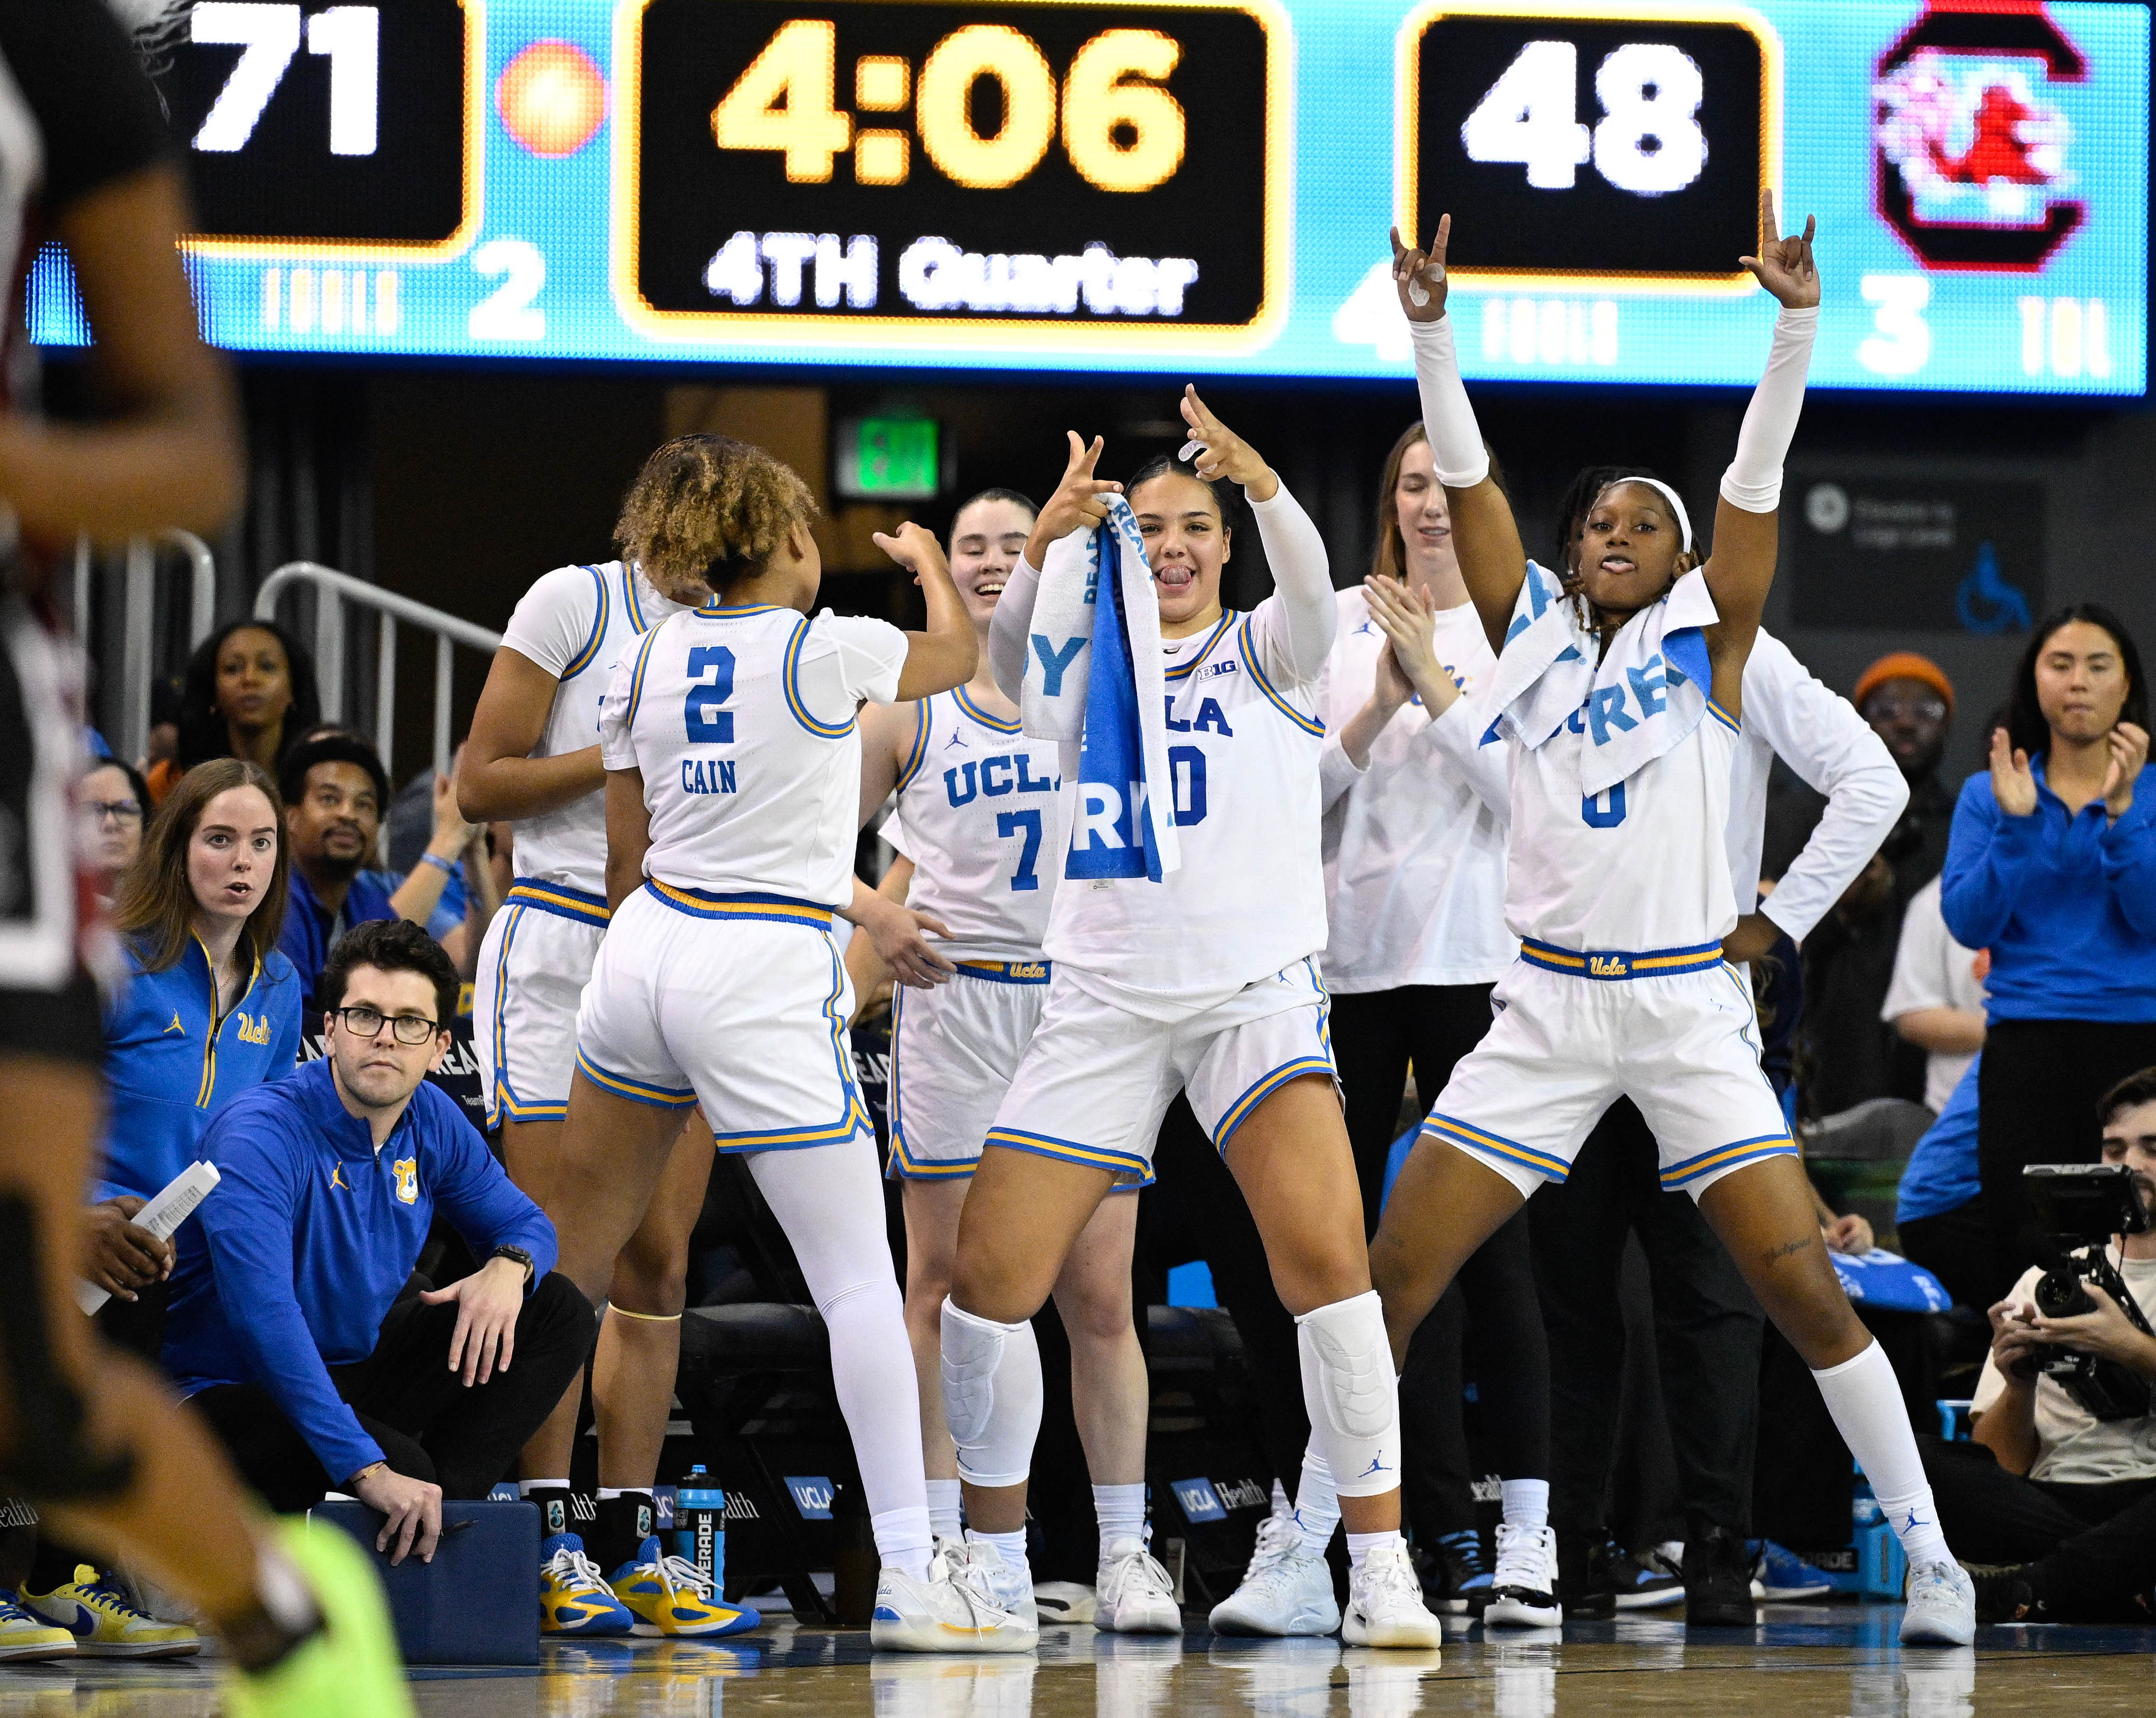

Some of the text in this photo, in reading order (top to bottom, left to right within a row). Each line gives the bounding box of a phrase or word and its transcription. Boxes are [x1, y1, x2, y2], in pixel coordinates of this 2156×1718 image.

[192, 1, 378, 155] 71
[711, 20, 1185, 192] 4:06
[1460, 40, 1708, 194] 48
[467, 240, 546, 340] 2
[702, 231, 1199, 316] 4TH Quarter
[1859, 275, 1930, 374] 3
[684, 645, 735, 744] 2
[682, 759, 737, 794] CAIN
[943, 754, 1060, 808] UCL
[997, 809, 1043, 892] 7
[1010, 961, 1046, 978] Ucla
[1590, 956, 1627, 976] Ucla
